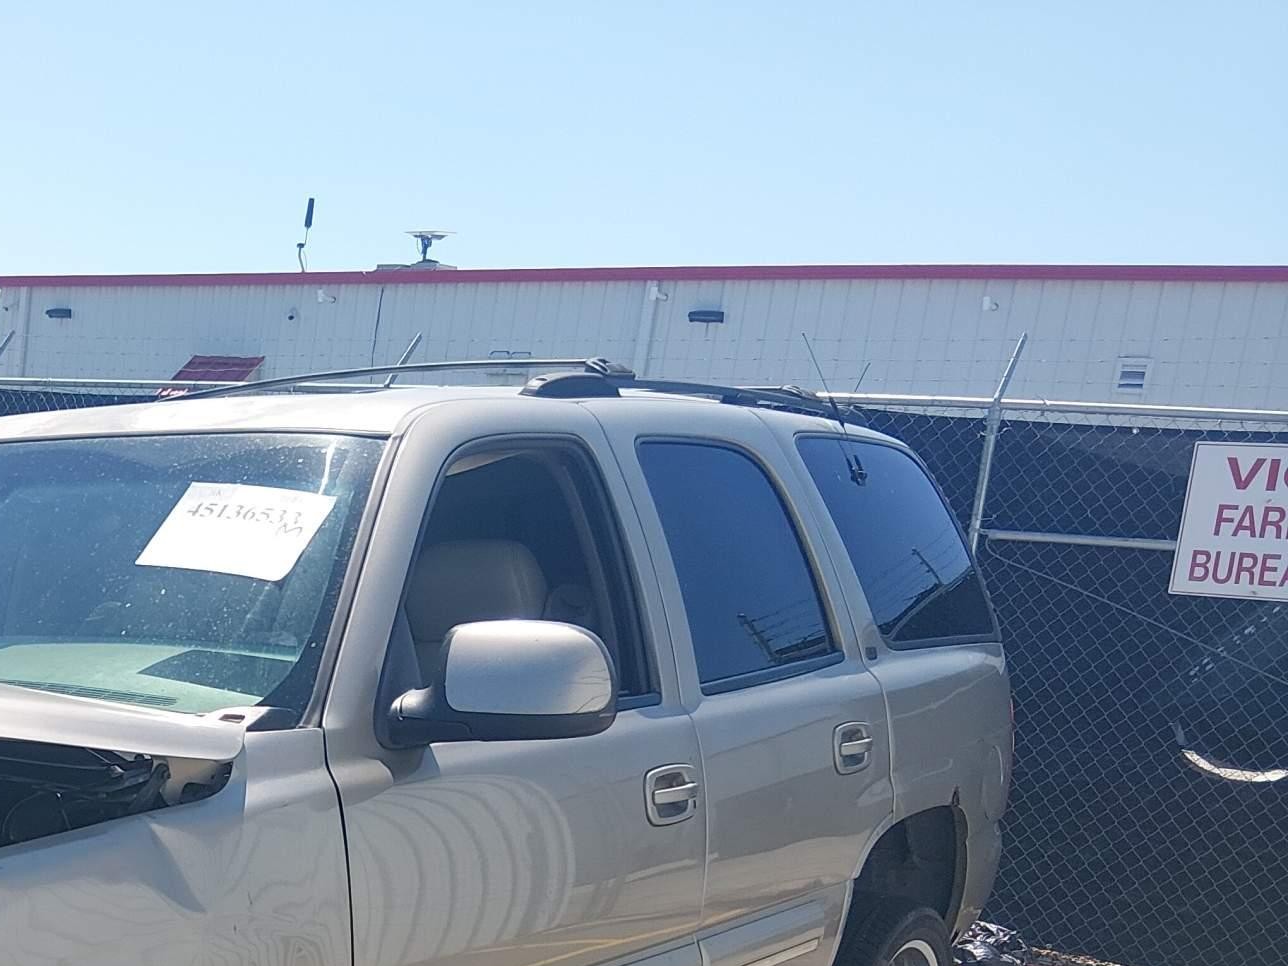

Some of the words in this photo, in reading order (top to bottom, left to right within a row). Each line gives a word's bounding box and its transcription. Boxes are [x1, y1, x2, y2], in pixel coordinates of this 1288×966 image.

[1227, 457, 1288, 491] VI
[187, 502, 302, 525] 45136533
[1213, 504, 1288, 539] FAR
